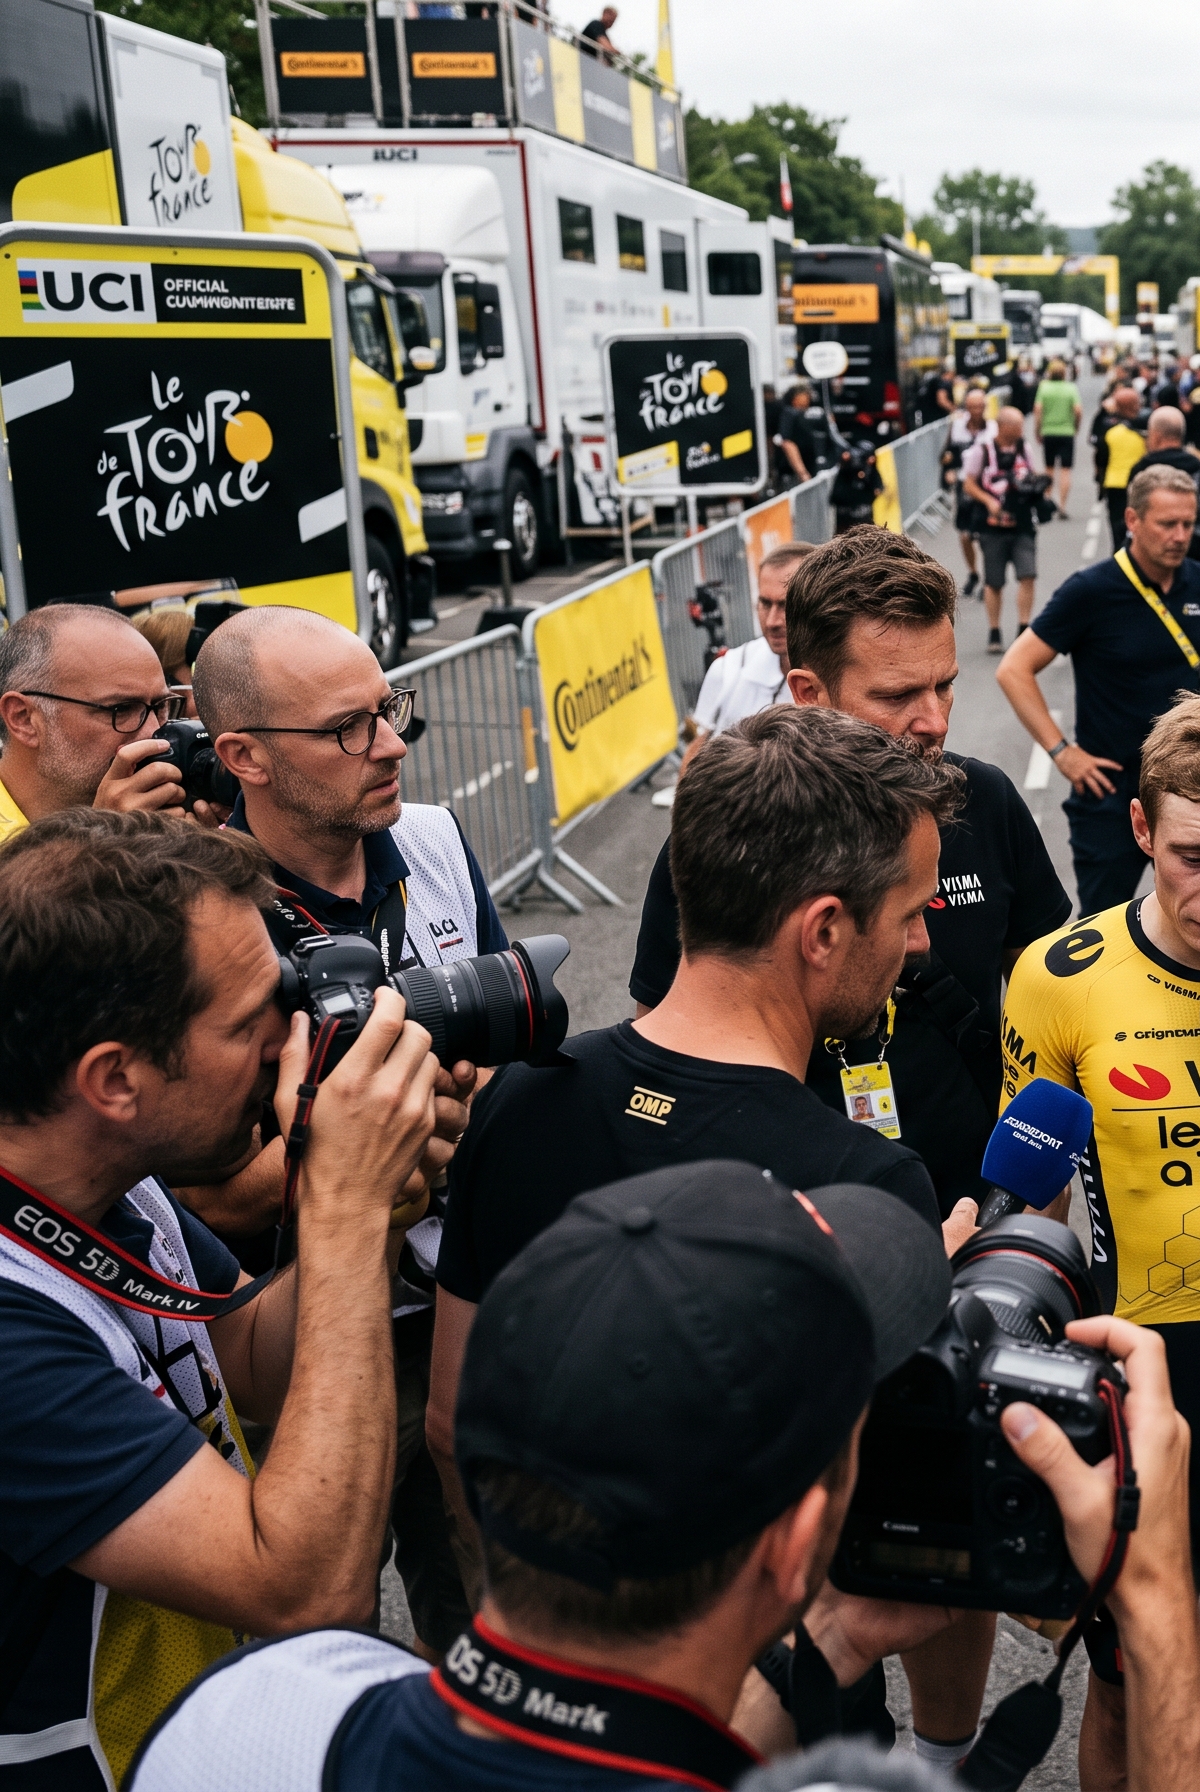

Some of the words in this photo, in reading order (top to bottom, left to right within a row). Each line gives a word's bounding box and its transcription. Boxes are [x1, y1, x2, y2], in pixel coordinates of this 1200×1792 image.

[42, 270, 145, 313] UCI
[164, 278, 230, 294] OFFICIAL
[97, 450, 118, 475] de
[942, 873, 982, 893] VISMA
[948, 889, 985, 907] VISMA
[629, 1092, 673, 1118] OMP
[1160, 1160, 1193, 1187] a
[14, 1204, 82, 1257] EOS
[79, 1247, 120, 1282] 5D
[122, 1278, 173, 1308] Mark
[177, 1298, 201, 1311] IV
[445, 1633, 485, 1686] OS
[478, 1660, 522, 1705] 5D
[523, 1686, 611, 1736] Mark
